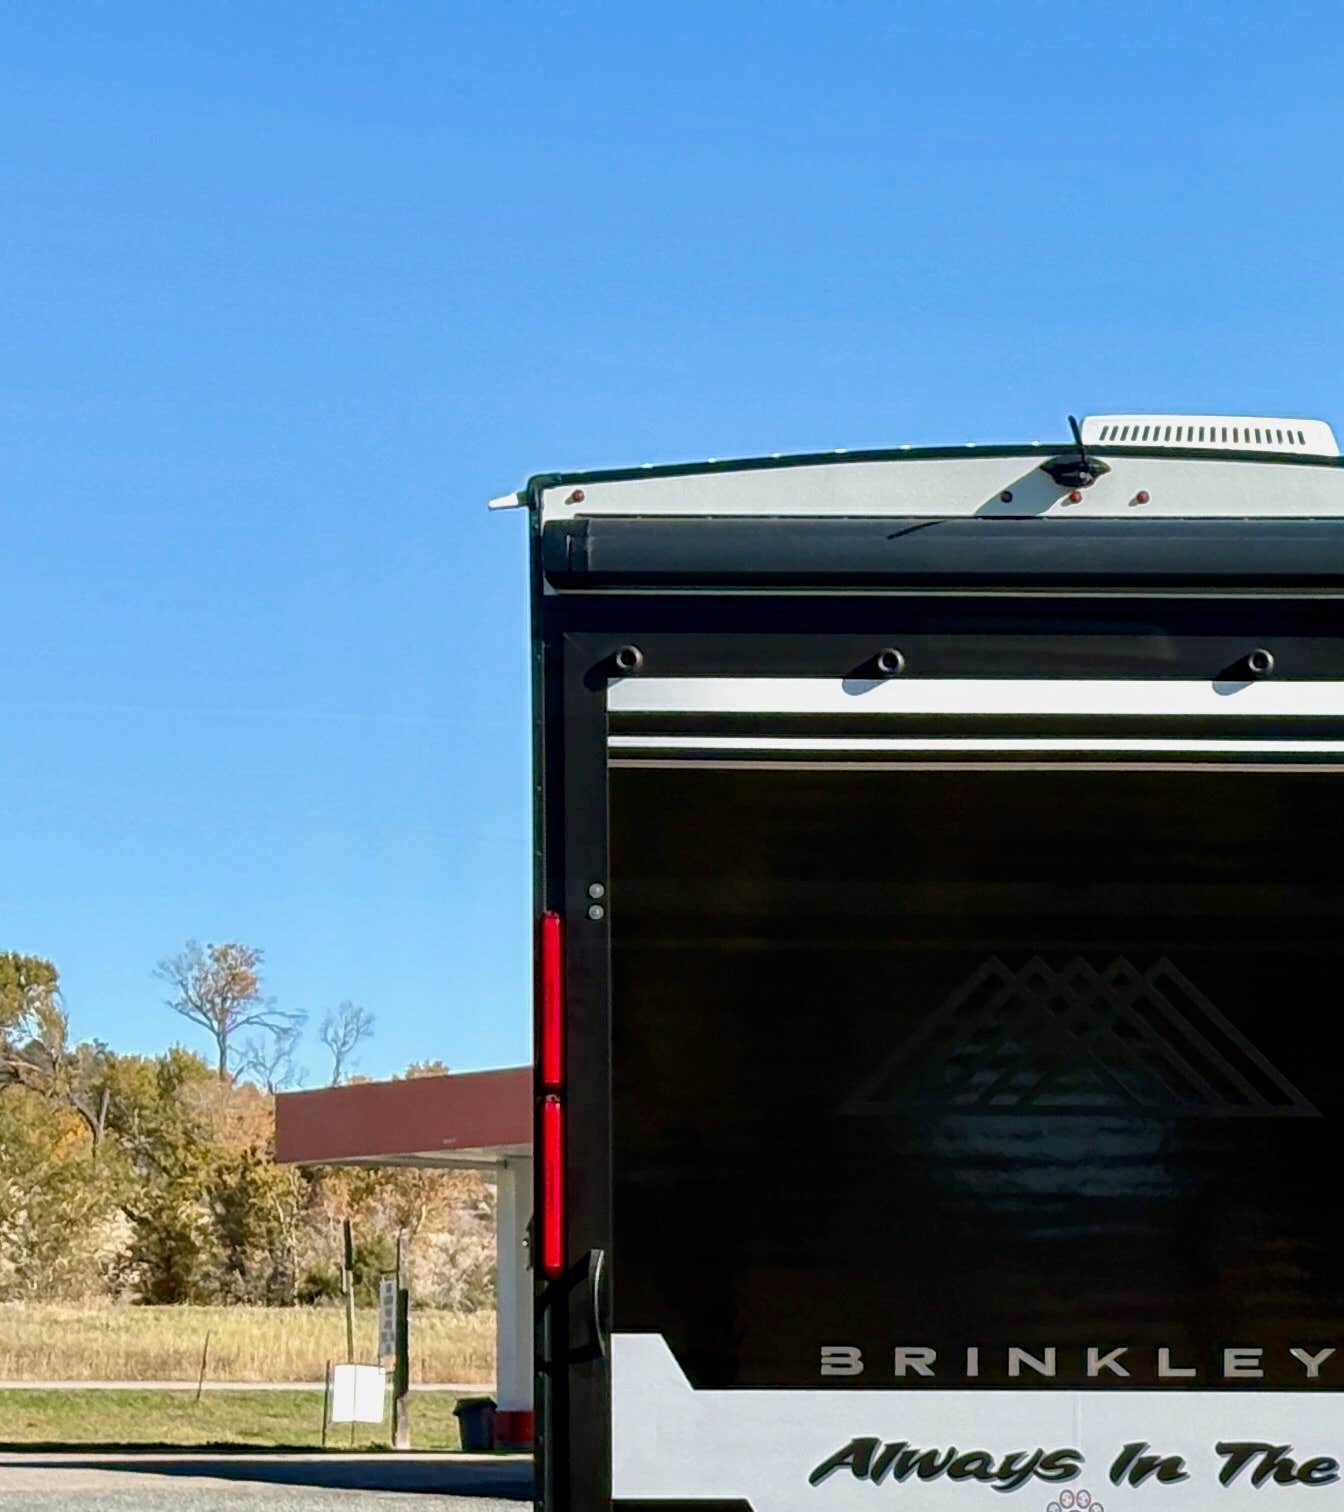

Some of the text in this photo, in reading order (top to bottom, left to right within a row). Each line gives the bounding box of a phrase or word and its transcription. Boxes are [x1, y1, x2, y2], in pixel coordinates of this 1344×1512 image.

[820, 1346, 1336, 1377] BRINKLEY
[808, 1436, 1342, 1493] Always In The
